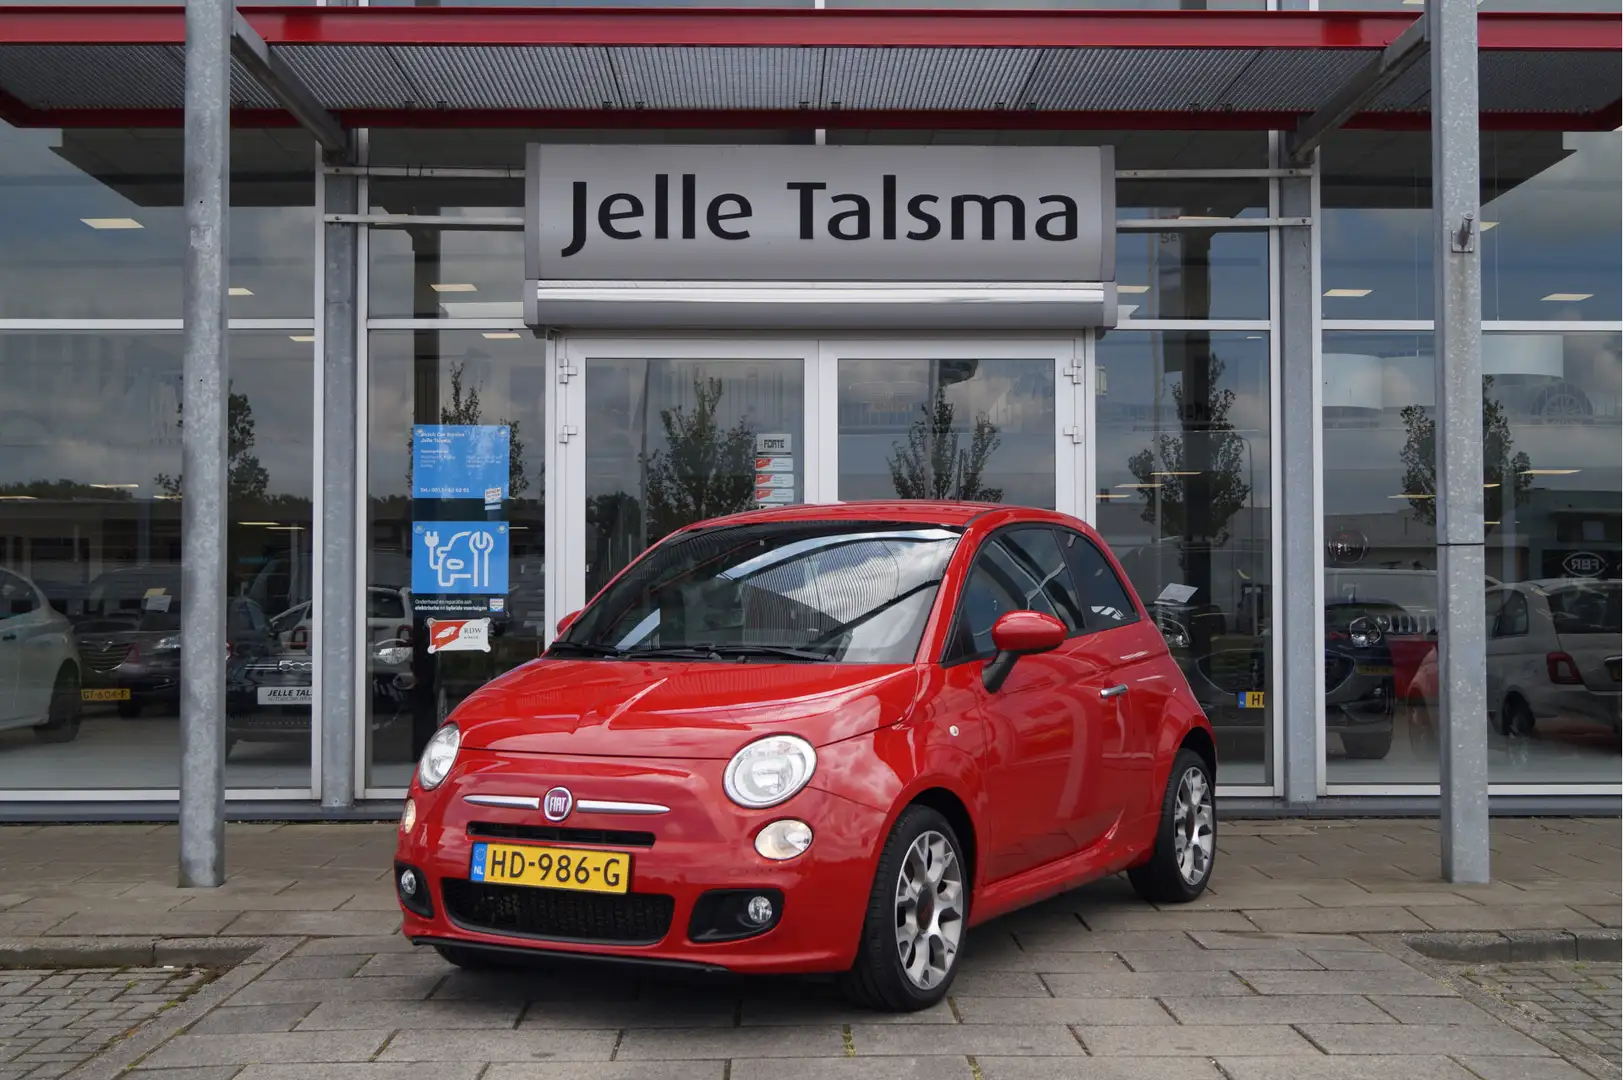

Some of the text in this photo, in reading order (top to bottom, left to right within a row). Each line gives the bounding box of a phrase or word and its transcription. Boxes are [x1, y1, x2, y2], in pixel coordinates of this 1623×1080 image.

[561, 173, 1079, 258] Jelle Talsma
[267, 689, 312, 697] JELLE TAL
[549, 797, 566, 812] FIAT
[474, 850, 620, 886] NL HD-986-G
